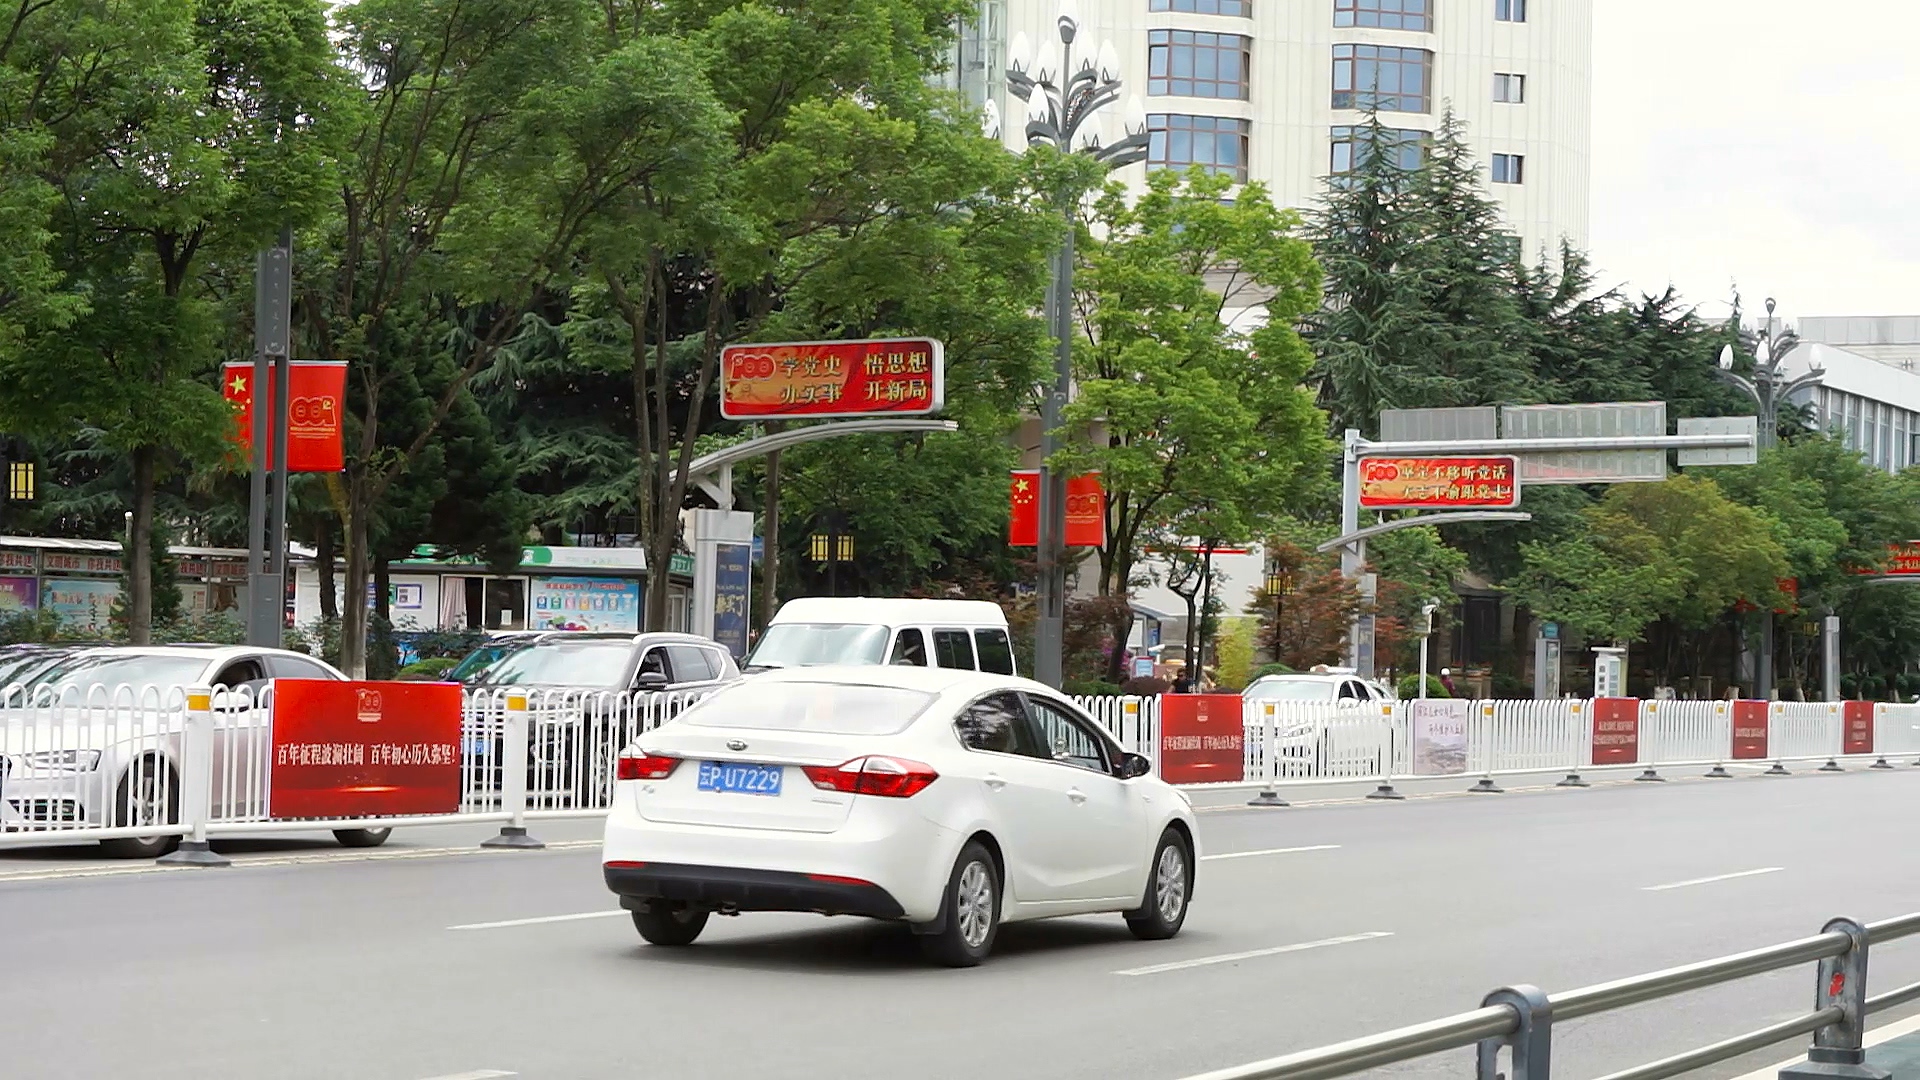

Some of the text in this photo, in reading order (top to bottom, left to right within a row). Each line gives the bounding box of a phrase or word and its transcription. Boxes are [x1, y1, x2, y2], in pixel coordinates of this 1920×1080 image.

[780, 351, 929, 378] 学党史 悟思想
[780, 380, 928, 405] 办实事 开新局
[1400, 464, 1507, 482] 坚定不移听党话
[277, 742, 365, 766] 百年征程波澜壮阔
